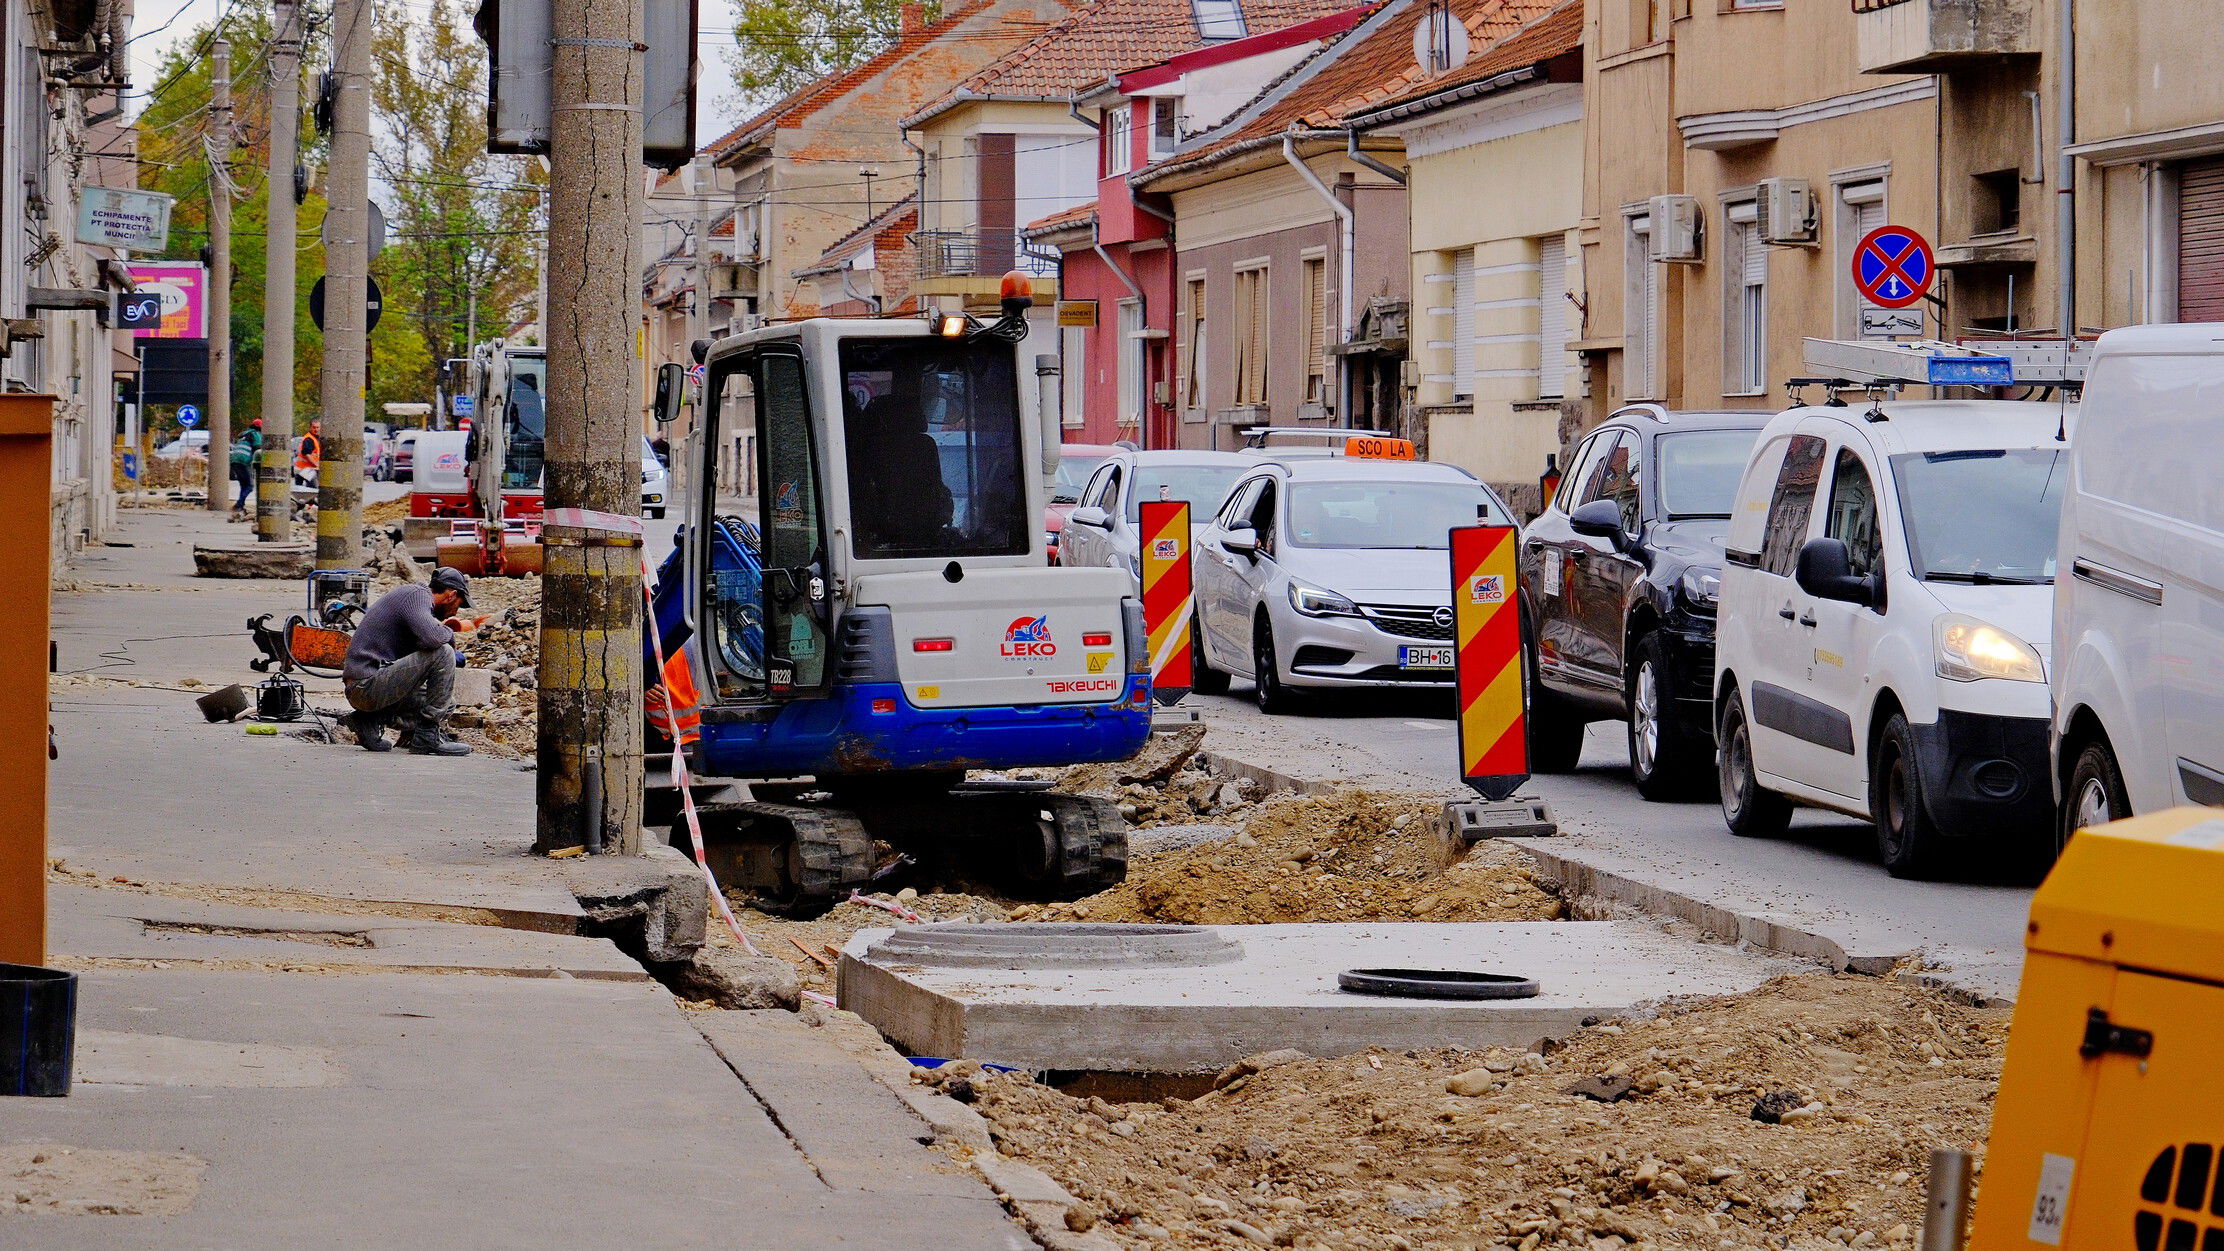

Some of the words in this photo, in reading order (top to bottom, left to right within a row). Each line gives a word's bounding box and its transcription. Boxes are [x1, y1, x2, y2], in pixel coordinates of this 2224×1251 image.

[92, 210, 152, 223] ECHIPAMENTE
[126, 304, 149, 316] EVA
[1358, 440, 1382, 455] SCO
[1390, 441, 1406, 456] LA
[1471, 592, 1502, 600] LEKO
[1000, 643, 1057, 656] LEKO
[770, 669, 791, 684] TB228
[1046, 680, 1117, 692] TAKEUCHI
